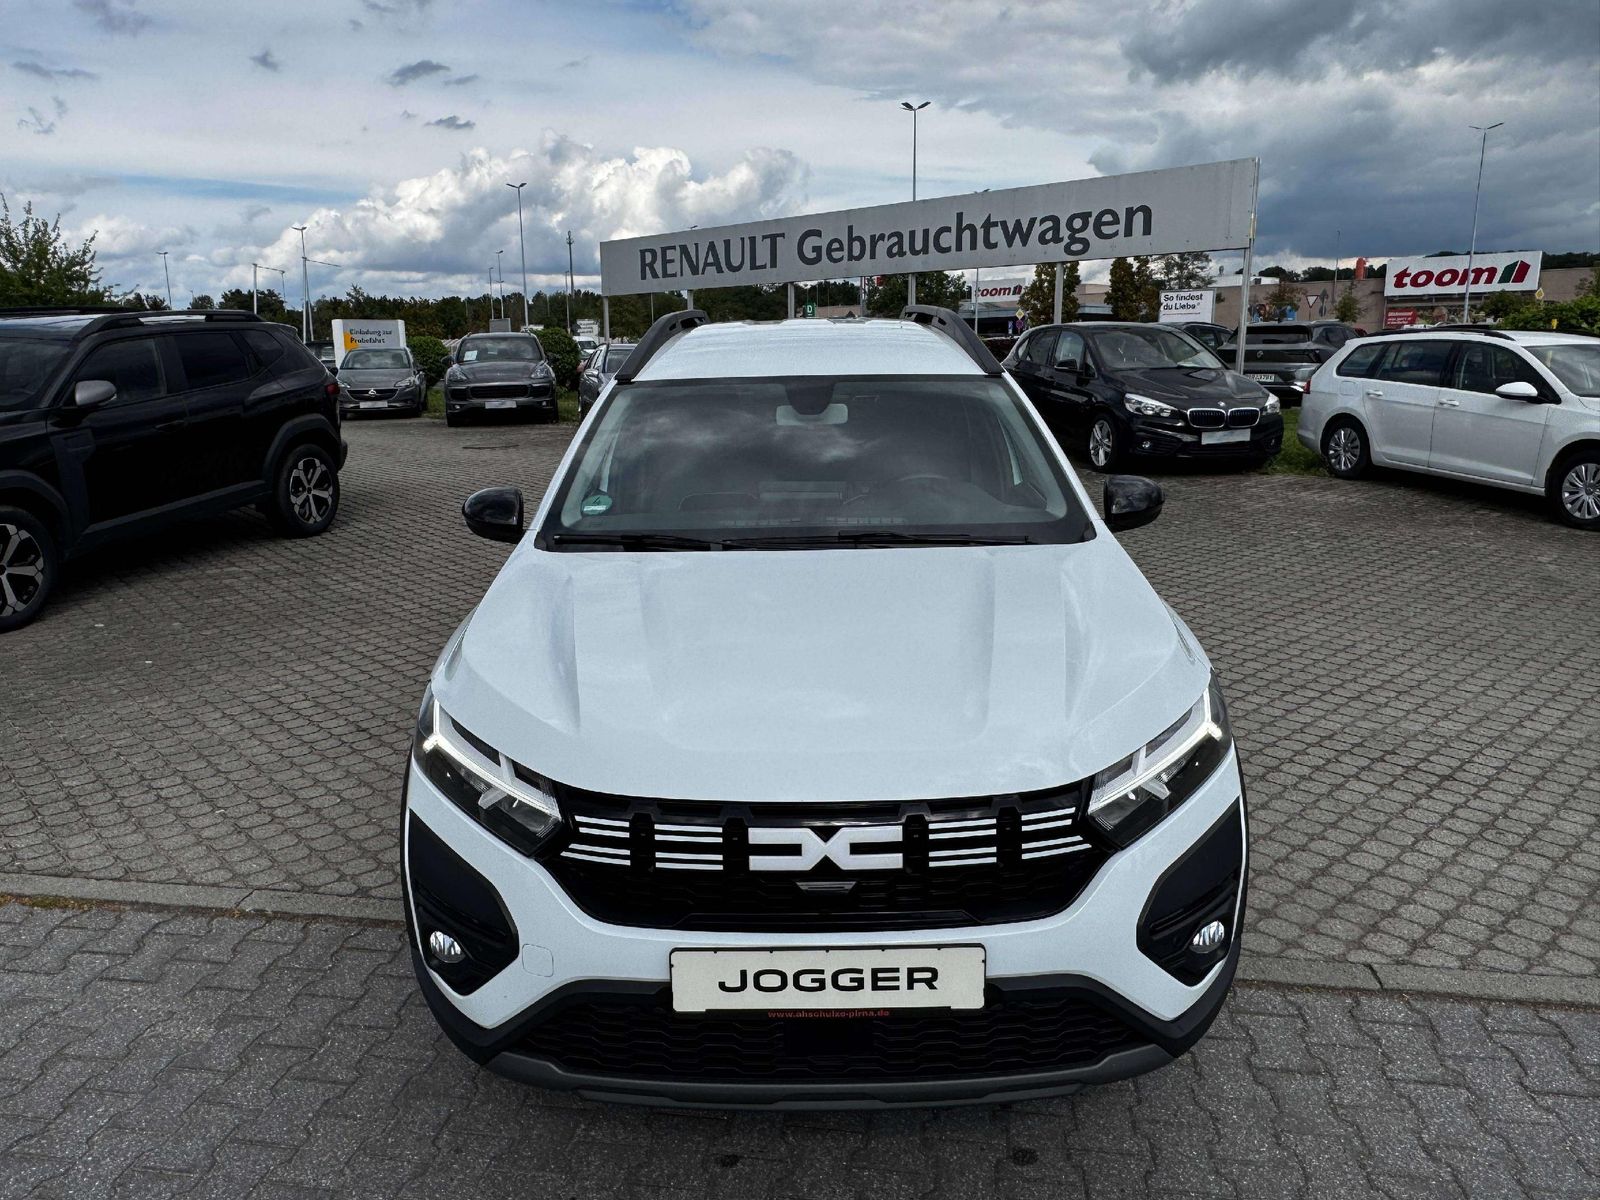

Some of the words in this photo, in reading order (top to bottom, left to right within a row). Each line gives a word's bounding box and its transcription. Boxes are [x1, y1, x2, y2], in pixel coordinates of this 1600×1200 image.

[639, 232, 786, 281] RENAULT
[797, 203, 1152, 256] Gebrauchtwagen
[1393, 266, 1498, 288] toom
[1163, 294, 1174, 302] So
[1175, 293, 1203, 301] findest
[1163, 302, 1173, 310] du
[718, 966, 939, 993] JOGGER
